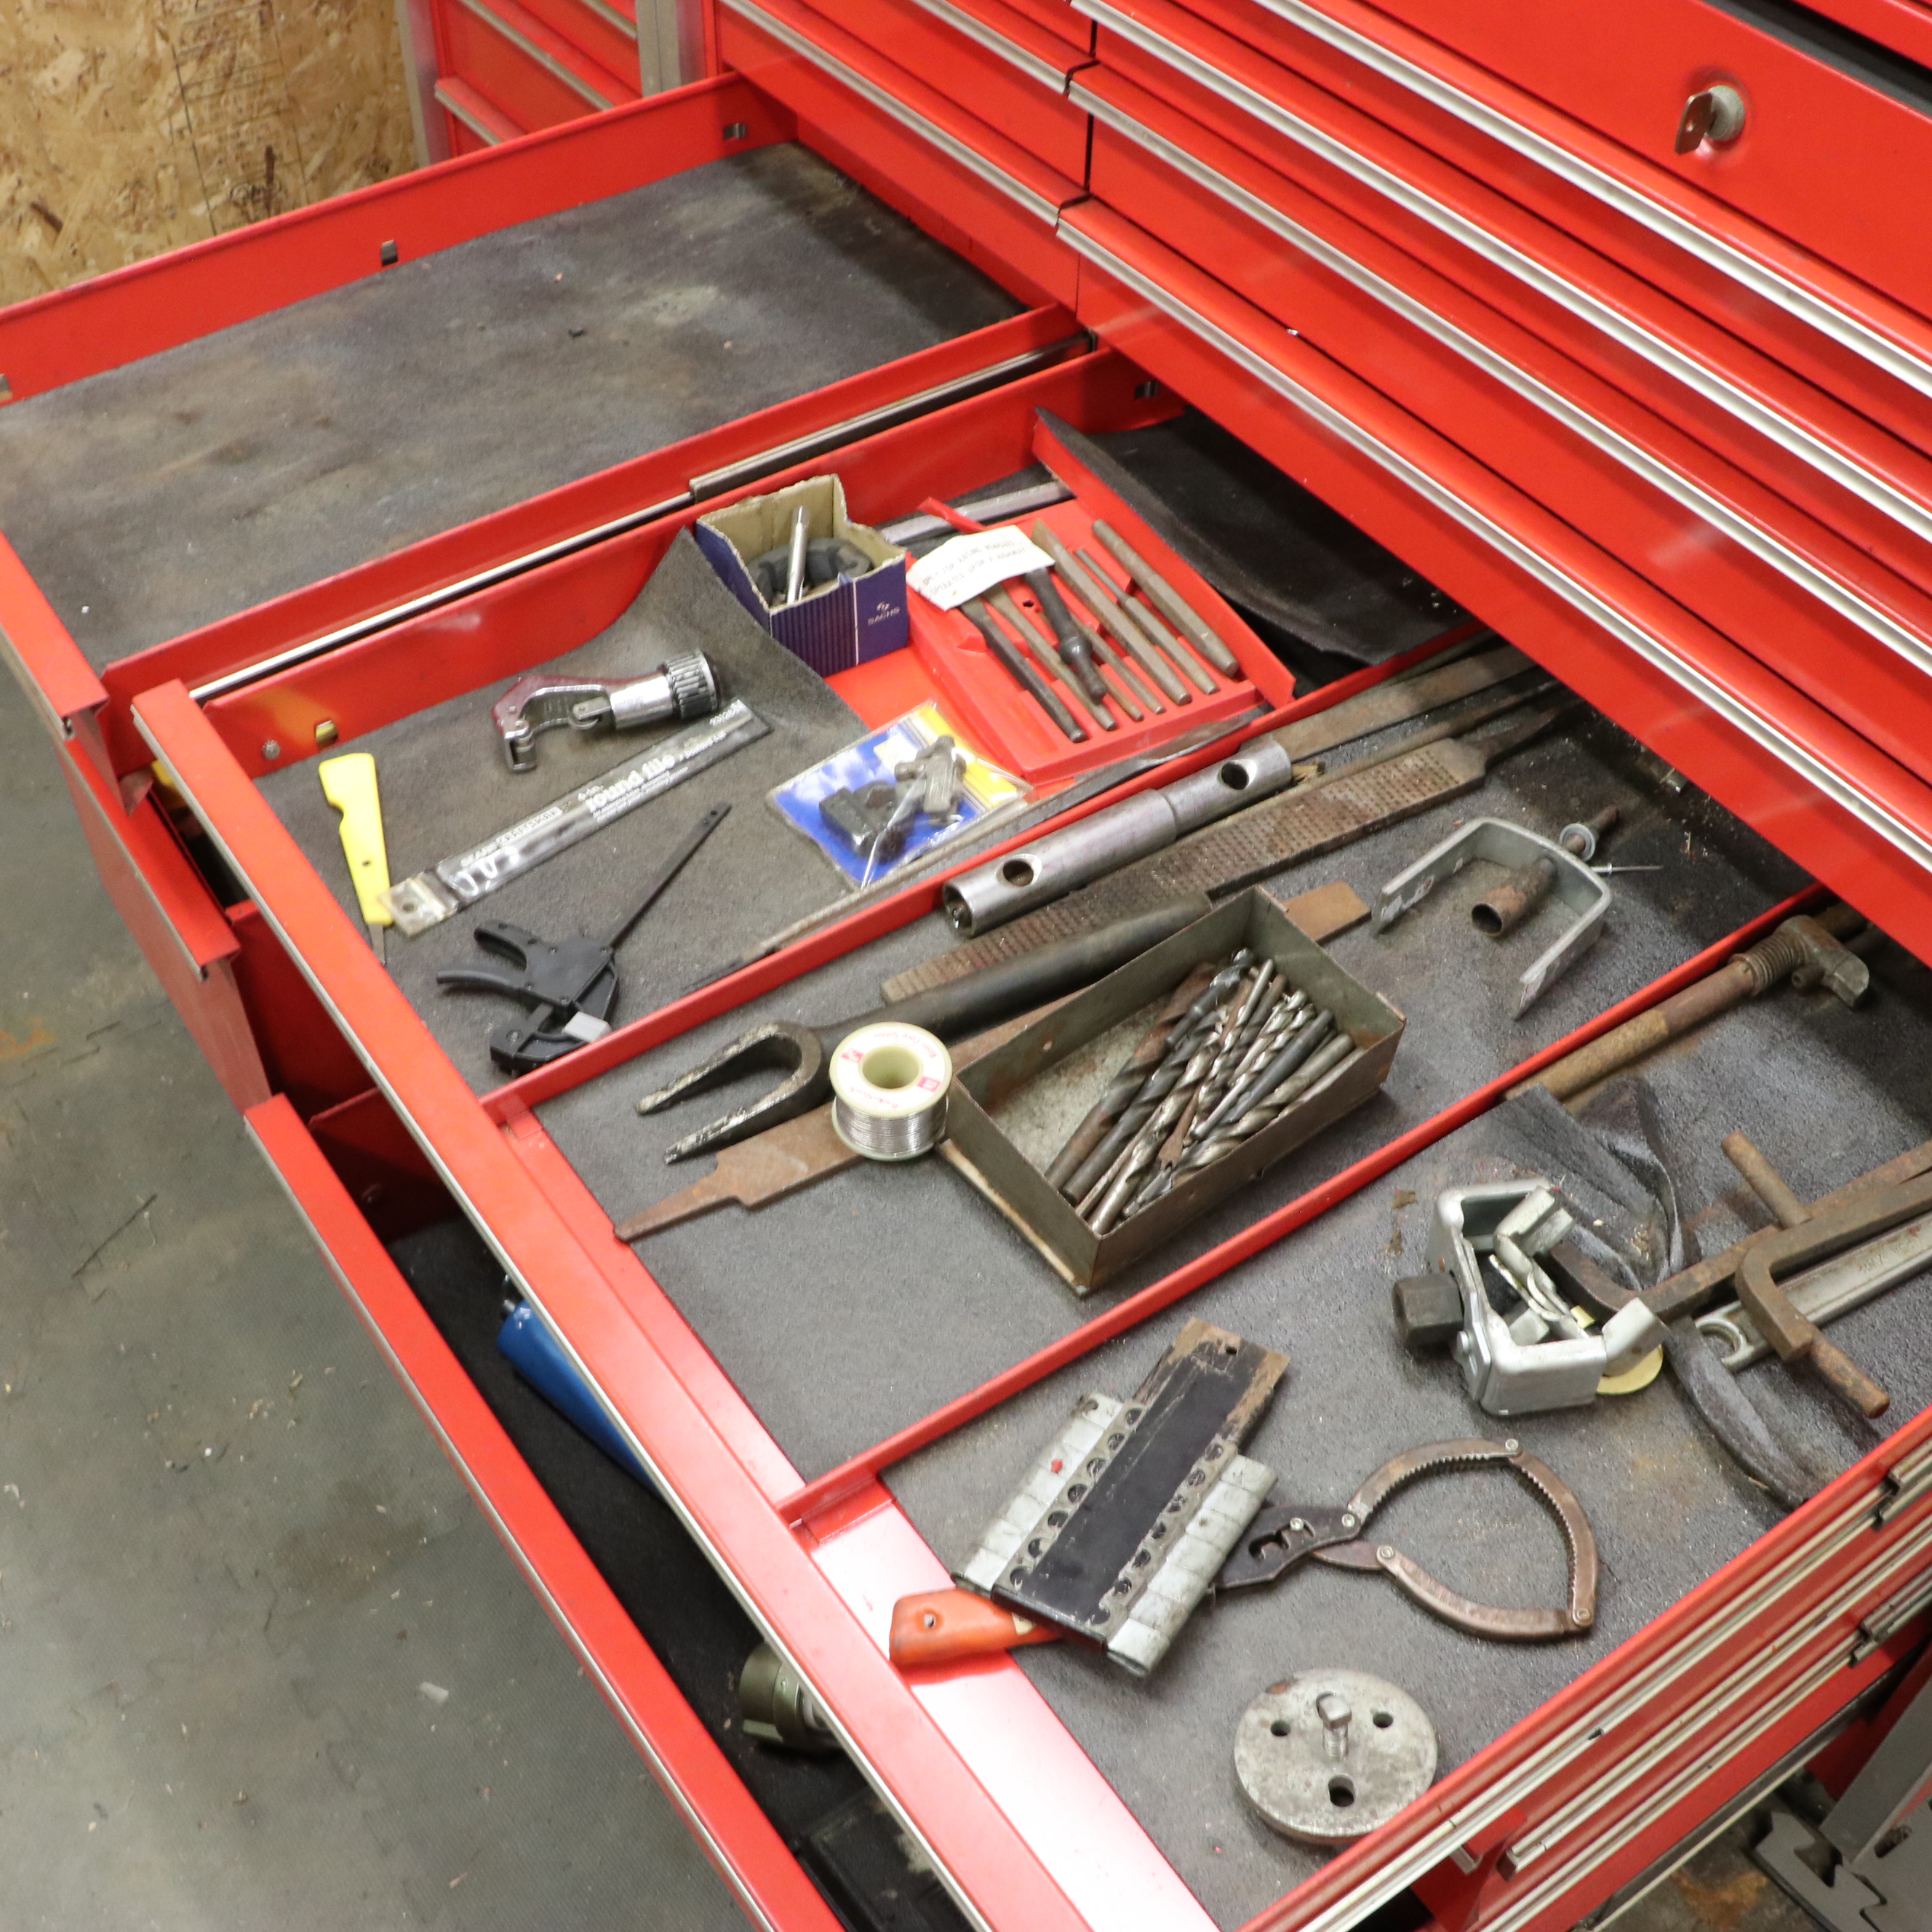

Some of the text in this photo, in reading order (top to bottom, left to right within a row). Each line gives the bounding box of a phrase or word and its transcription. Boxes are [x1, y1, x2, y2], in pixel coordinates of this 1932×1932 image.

[868, 607, 901, 626] SACHS
[586, 770, 644, 813] round
[642, 754, 675, 780] file
